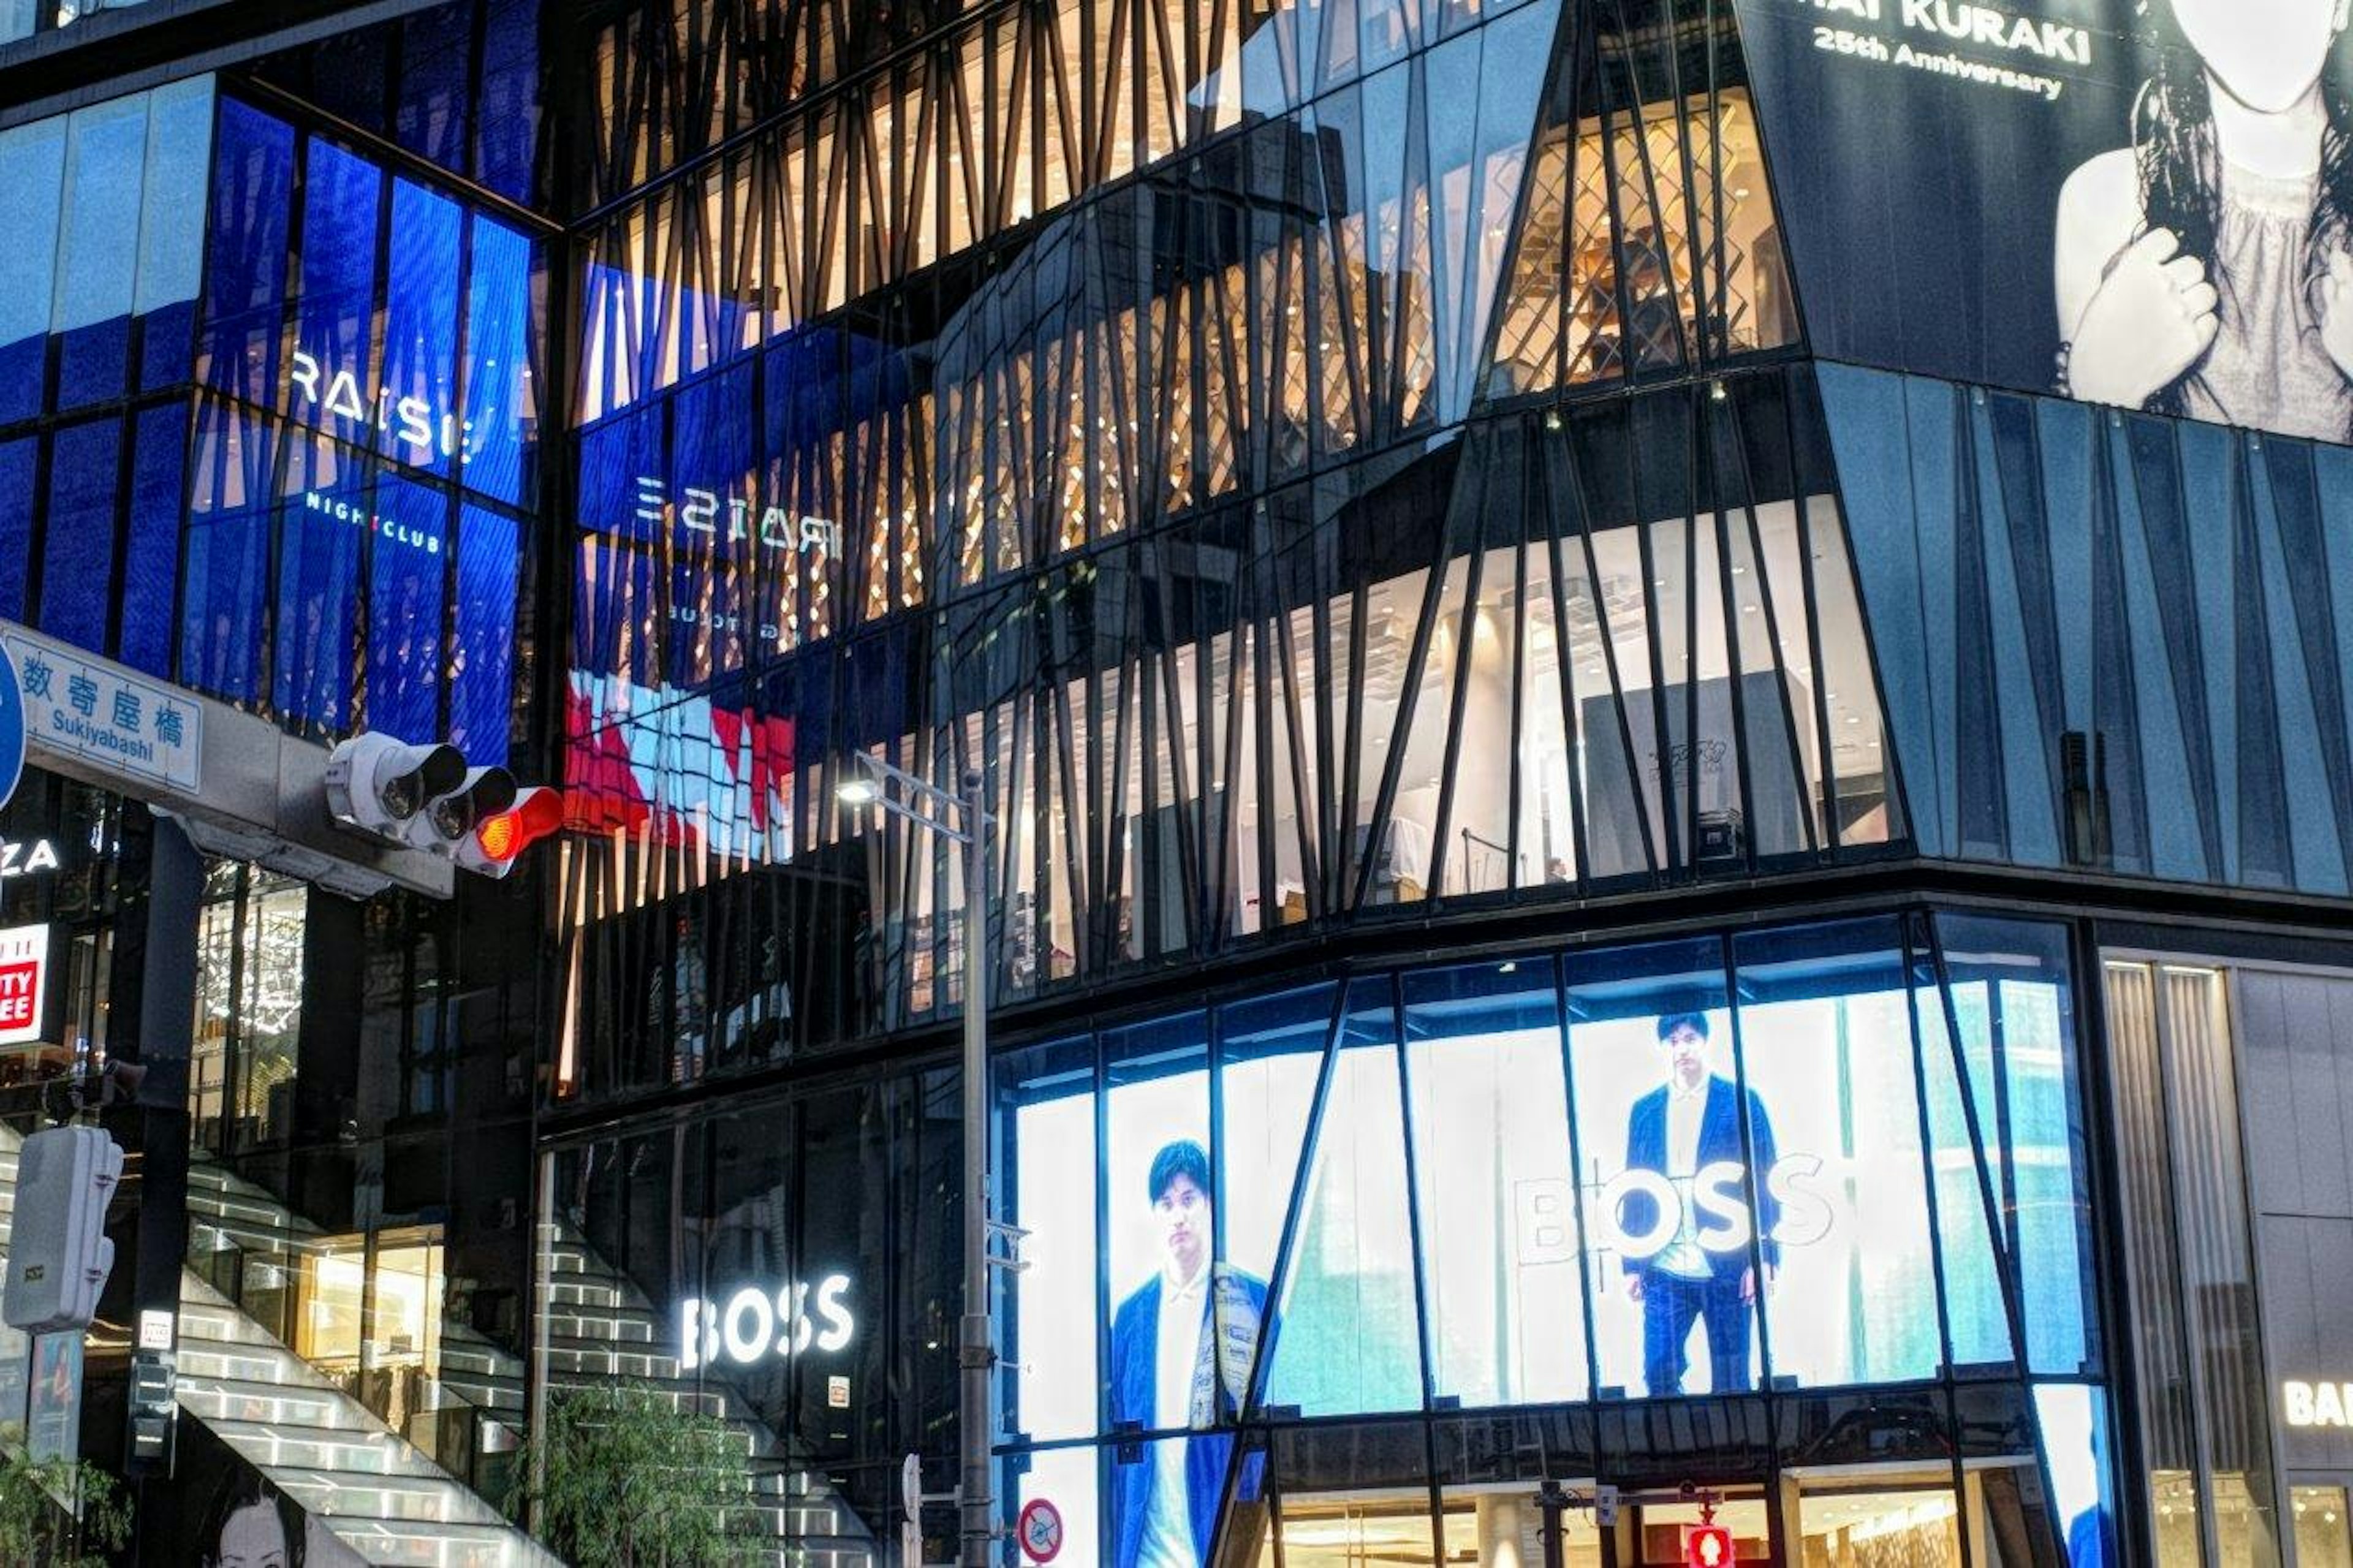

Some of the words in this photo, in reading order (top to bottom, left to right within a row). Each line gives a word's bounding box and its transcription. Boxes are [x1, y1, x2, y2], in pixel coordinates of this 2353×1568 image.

[1813, 26, 1889, 61] 25th
[1894, 44, 2063, 100] Anniversary
[1901, 0, 2091, 65] KURAKI
[23, 652, 183, 749] 数寄屋橋
[53, 709, 153, 762] Sukiyabashi
[1514, 1152, 1833, 1267] BOSS
[683, 1274, 854, 1369] BOSS
